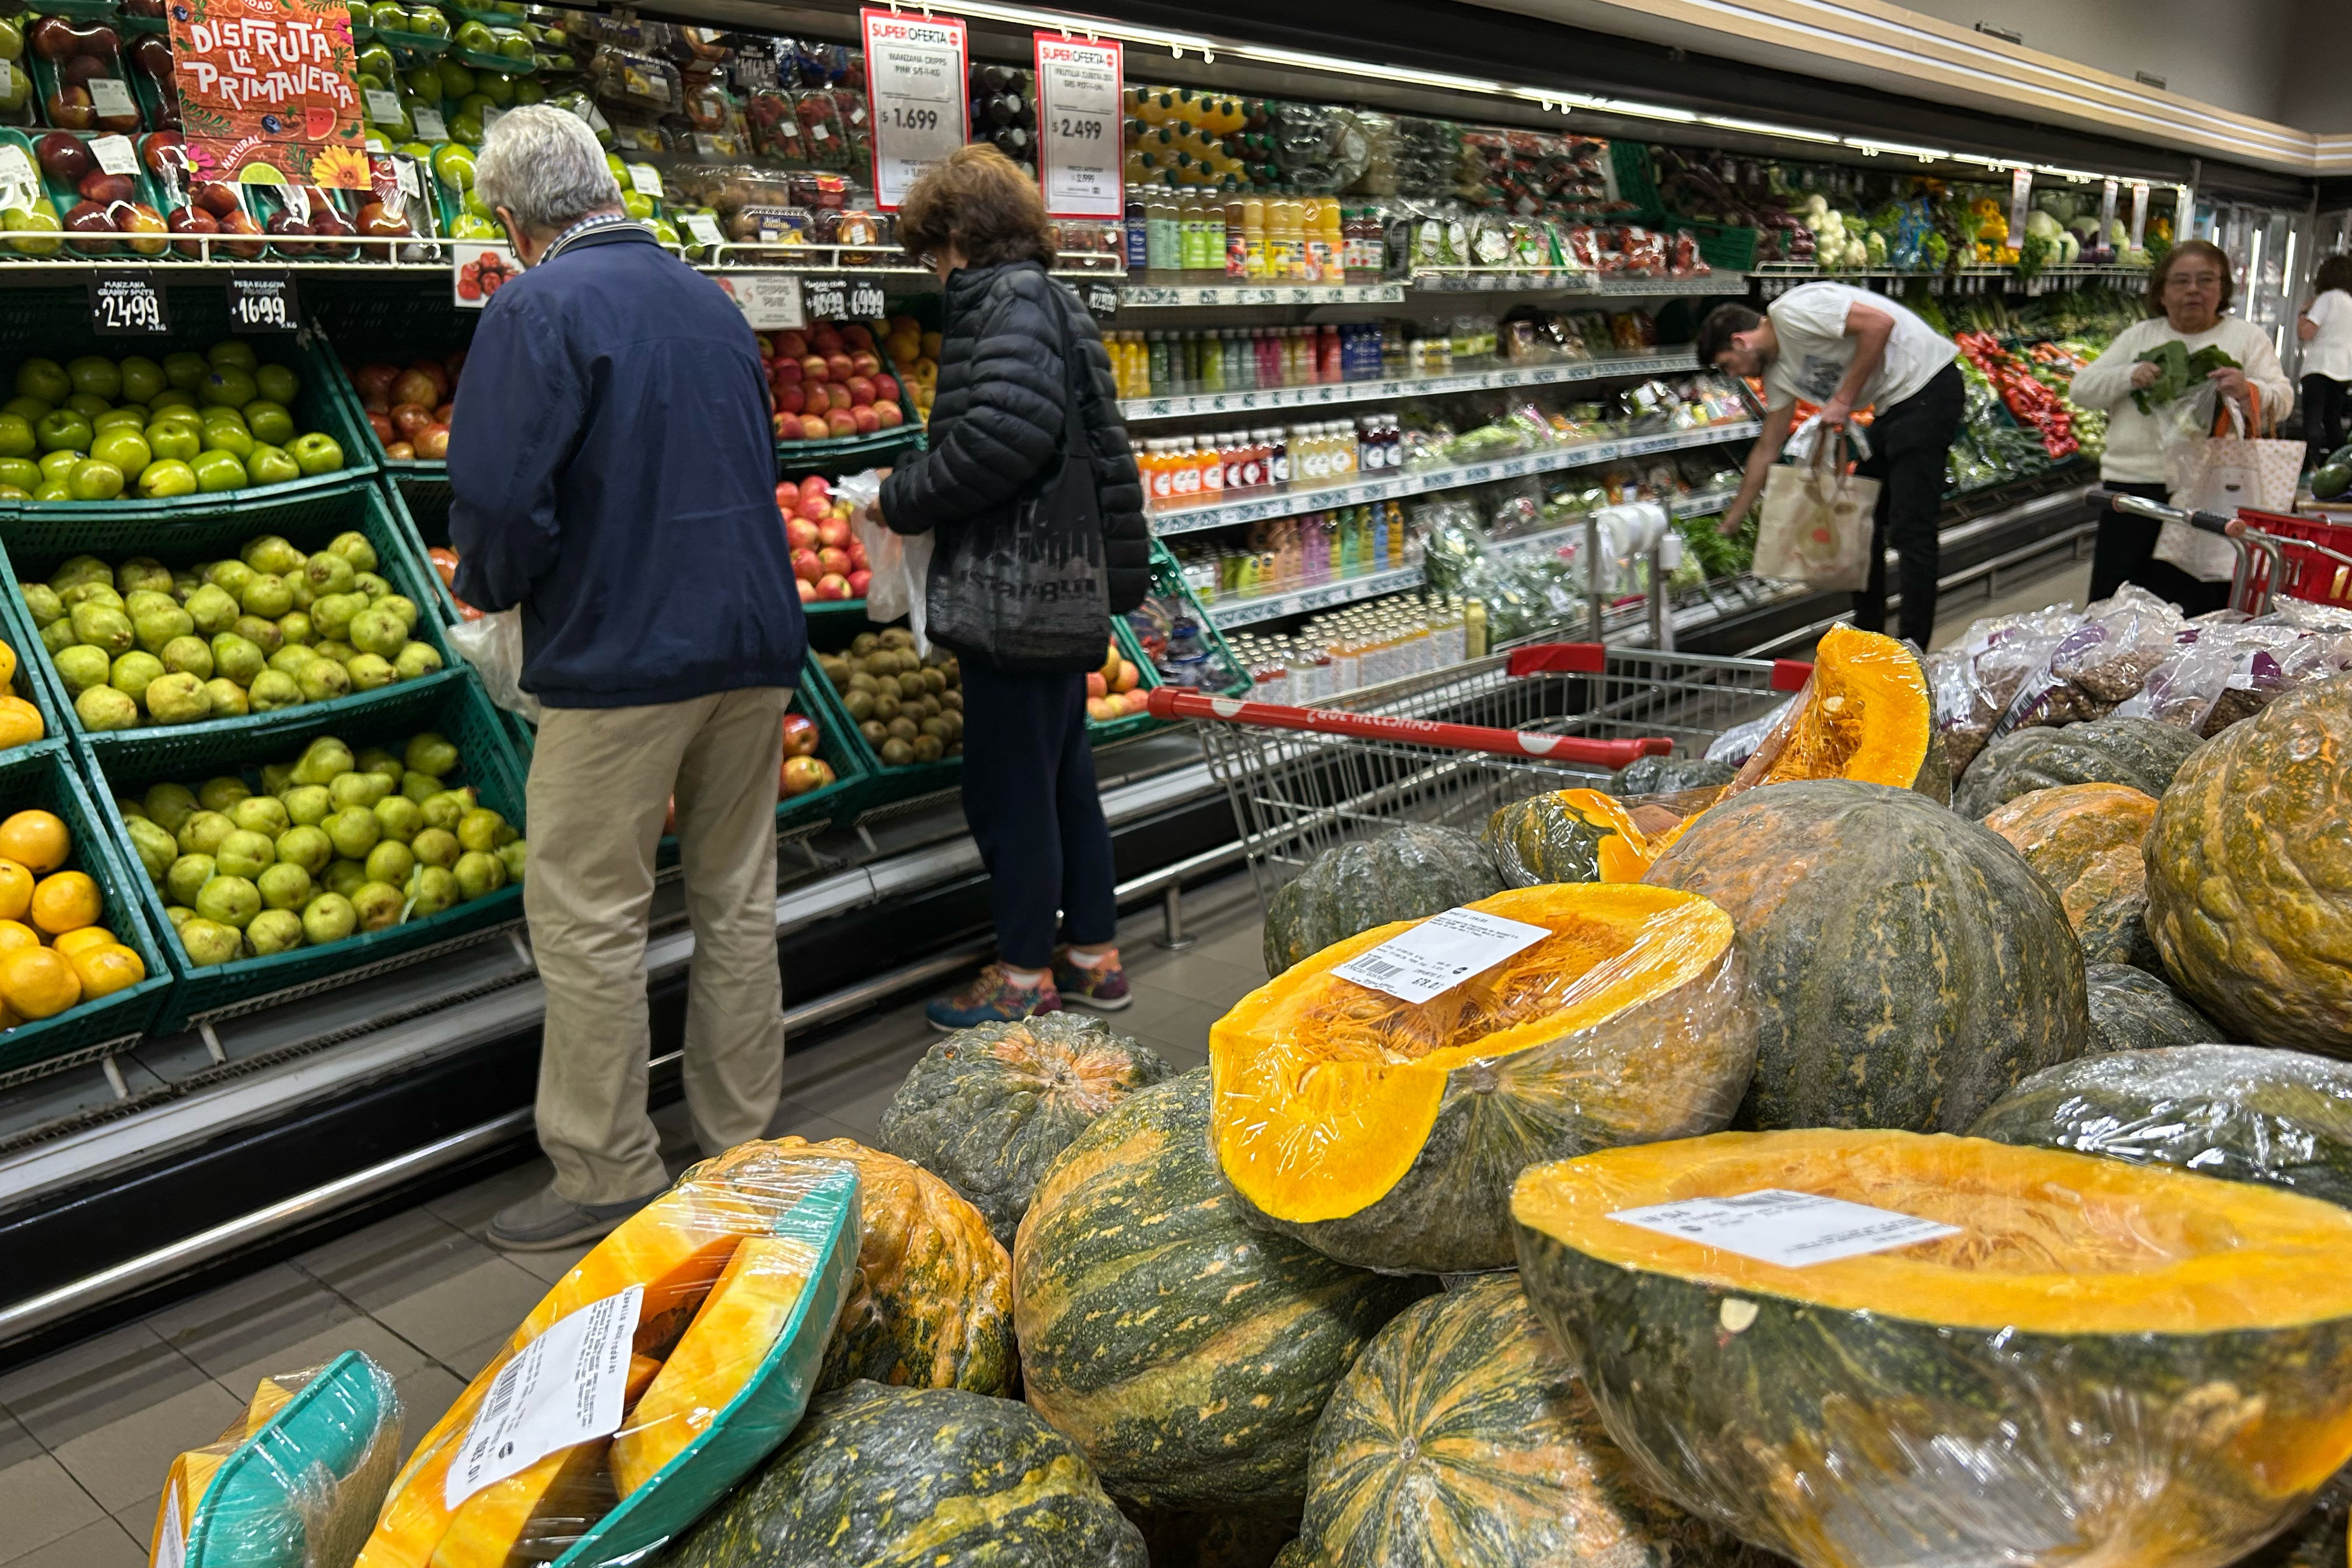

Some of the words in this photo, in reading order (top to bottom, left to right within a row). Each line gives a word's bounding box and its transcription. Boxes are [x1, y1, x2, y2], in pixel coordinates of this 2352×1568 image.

[190, 18, 331, 68] DISFRUTÁ
[228, 48, 257, 75] LA
[182, 63, 354, 111] PRIMAVERA
[894, 108, 938, 131] 1.699
[1062, 118, 1102, 140] 2.499
[221, 135, 262, 170] NATURAL
[102, 295, 159, 327] 2499
[239, 296, 286, 324] 1699
[619, 1290, 632, 1321] Zapallo
[615, 1324, 625, 1340] anco
[608, 1338, 618, 1374] rodajas
